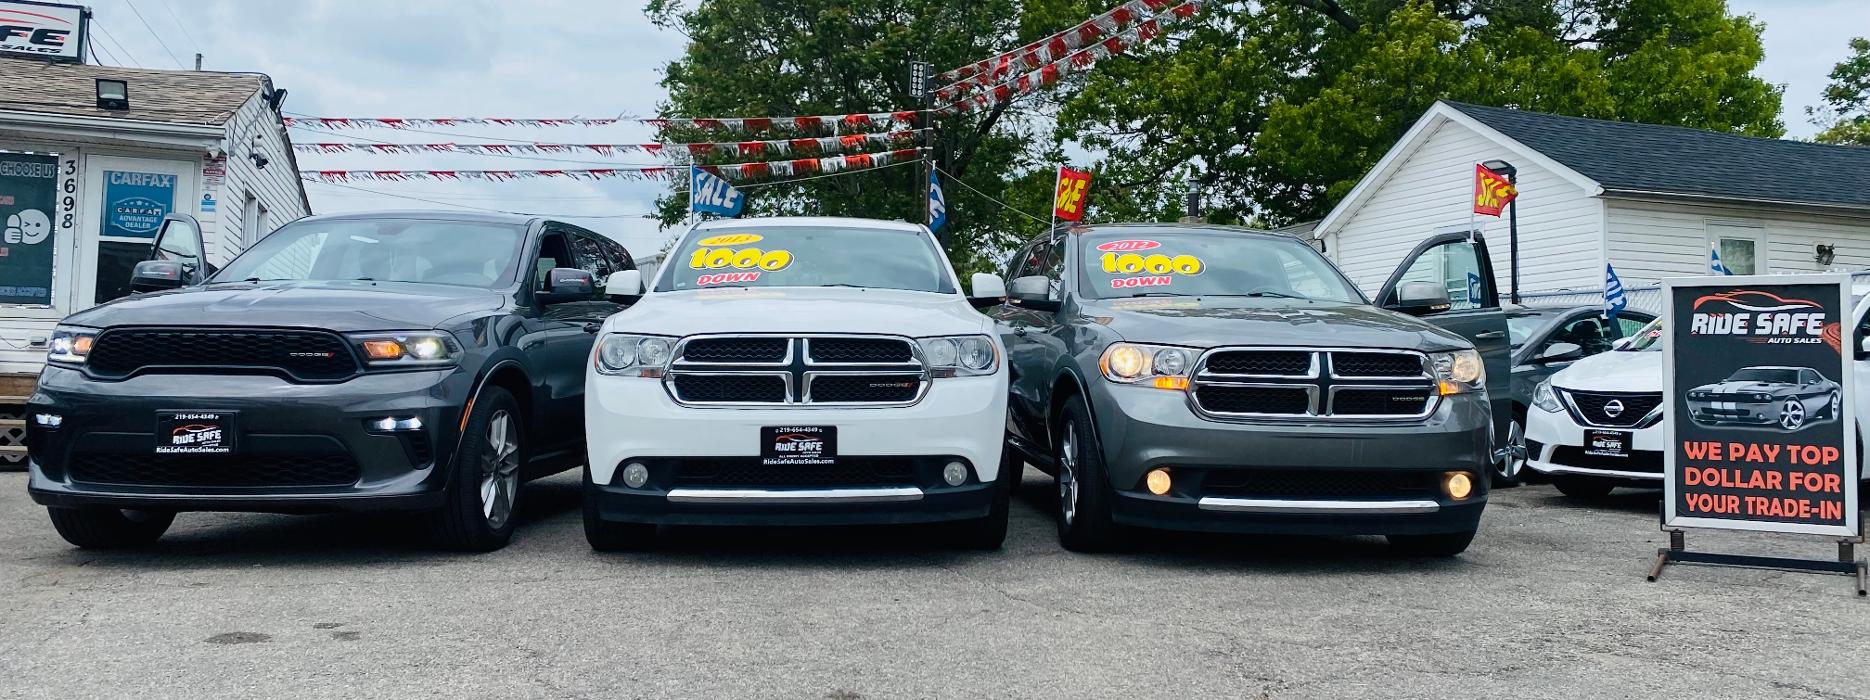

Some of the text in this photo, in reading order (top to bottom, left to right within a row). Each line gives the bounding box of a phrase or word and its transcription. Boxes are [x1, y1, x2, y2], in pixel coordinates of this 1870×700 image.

[0, 45, 62, 53] SALES
[0, 161, 56, 178] CHOOSE US
[110, 171, 171, 188] CARFAX
[62, 160, 76, 228] 3698
[694, 172, 739, 209] SALE
[1056, 177, 1087, 214] SALE
[117, 207, 162, 216] CARFAX
[119, 214, 158, 223] ADVANTAGE
[124, 221, 151, 229] DEALER
[1110, 241, 1151, 250] 2012
[689, 247, 795, 272] 1000
[1100, 252, 1206, 276] 1000
[696, 272, 761, 286] DOWN
[1110, 276, 1172, 289] DOWN
[1690, 312, 1826, 336] RIDE SAFE
[173, 434, 196, 444] RIDE
[197, 430, 222, 442] SAFE
[775, 442, 823, 451] RIDE SAFE
[1684, 441, 1840, 465] WE PAY TOP
[1684, 466, 1841, 493] DOLLAR FOR
[1685, 492, 1842, 520] YOUR TRADE-IN
